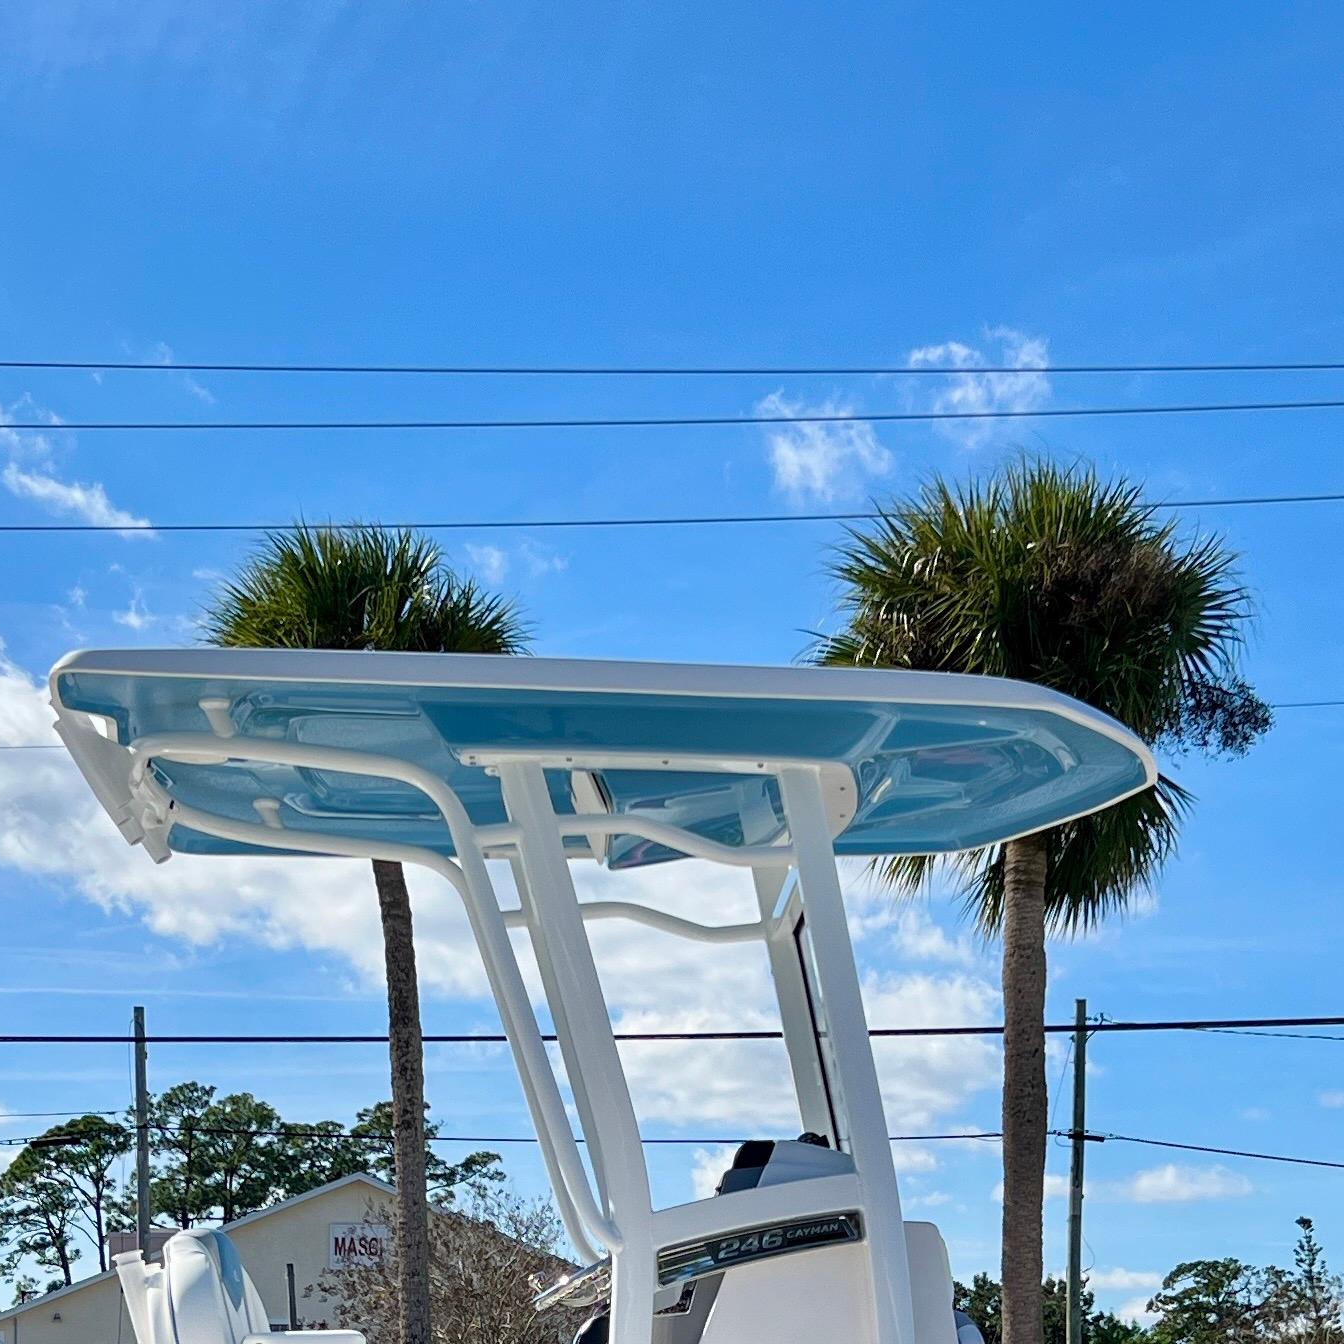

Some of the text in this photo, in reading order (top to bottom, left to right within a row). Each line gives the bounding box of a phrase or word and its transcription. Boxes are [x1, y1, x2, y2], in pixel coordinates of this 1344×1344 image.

[334, 1236, 384, 1257] MASCI
[718, 1223, 839, 1259] 246 CAYMAN
